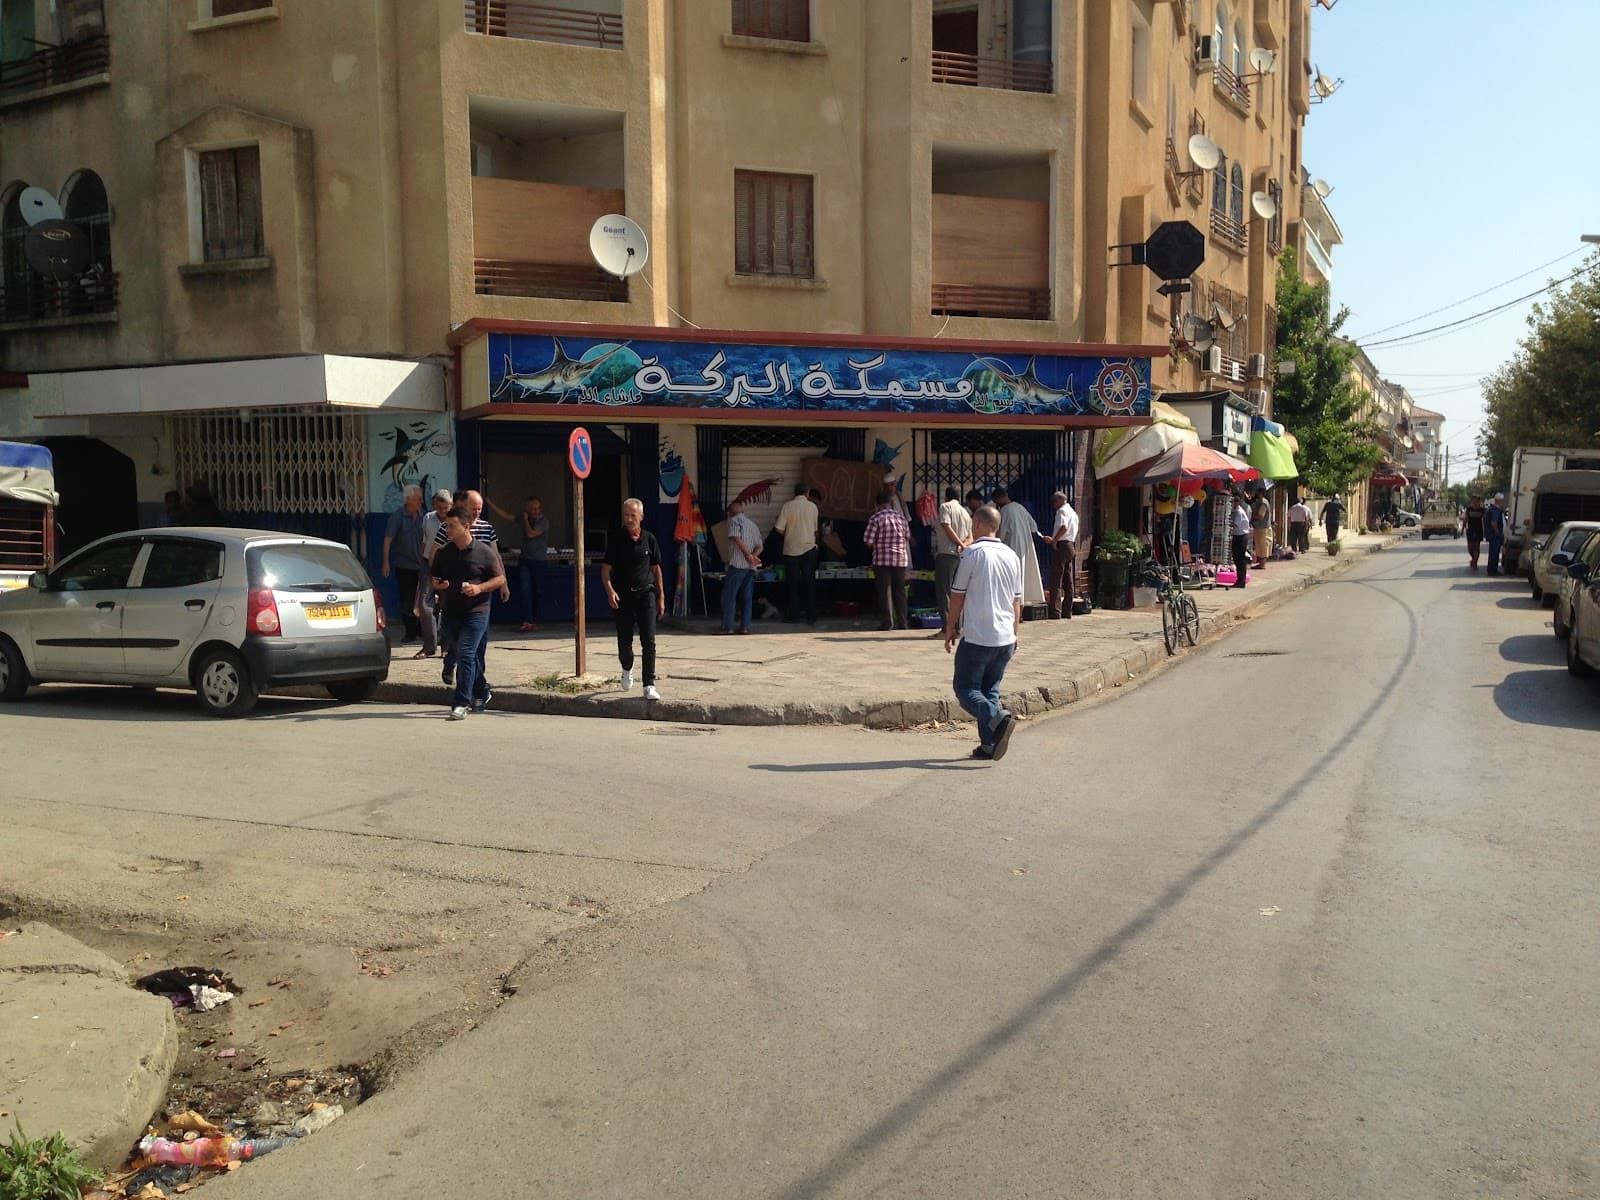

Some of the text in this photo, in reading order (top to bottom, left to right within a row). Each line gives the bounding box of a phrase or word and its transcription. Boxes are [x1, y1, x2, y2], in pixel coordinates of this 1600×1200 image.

[633, 349, 975, 407] مسمكة البركة
[578, 385, 599, 404] الله
[973, 391, 1015, 411] بسم الله
